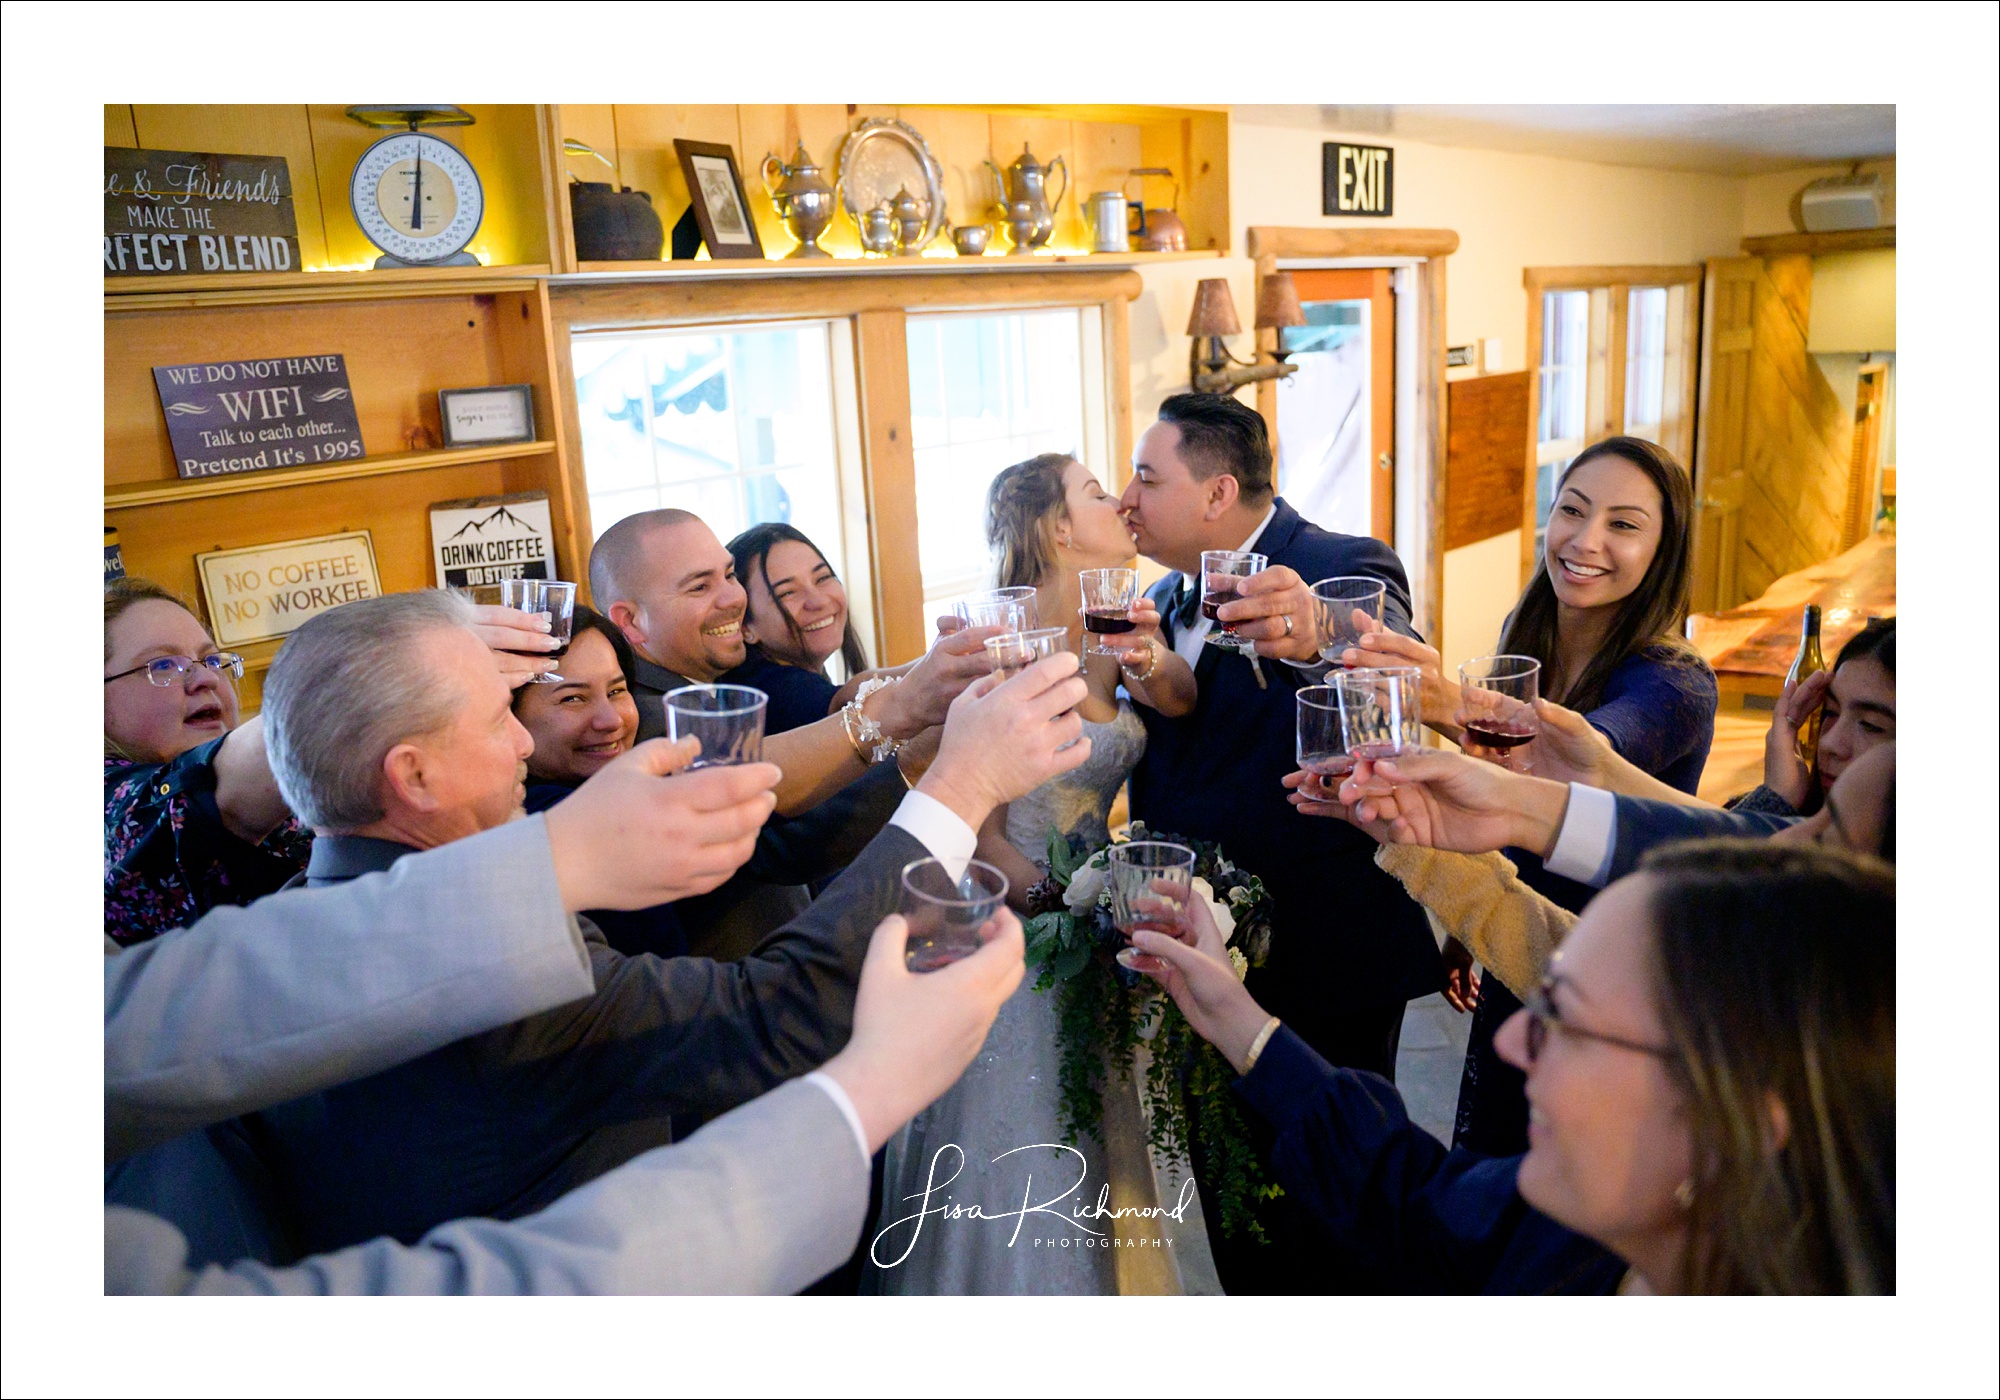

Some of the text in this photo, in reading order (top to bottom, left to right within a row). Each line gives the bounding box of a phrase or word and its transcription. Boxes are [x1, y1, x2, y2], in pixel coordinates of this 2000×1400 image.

[133, 168, 161, 201] &
[165, 164, 280, 206] Friends
[1338, 146, 1388, 212] EXIT
[127, 205, 216, 230] MAKE THE
[198, 234, 291, 272] BLEND
[167, 356, 339, 386] WE DO NOT HAVE
[217, 385, 307, 423] WIFI
[200, 420, 347, 448] Talk to each other...
[182, 440, 361, 477] Pretend It's 1995
[441, 537, 545, 567] DRINK COFFEE
[223, 555, 359, 595] NO COFFEE
[466, 564, 525, 586] DO STUFF
[222, 580, 371, 623] NO WORKEE
